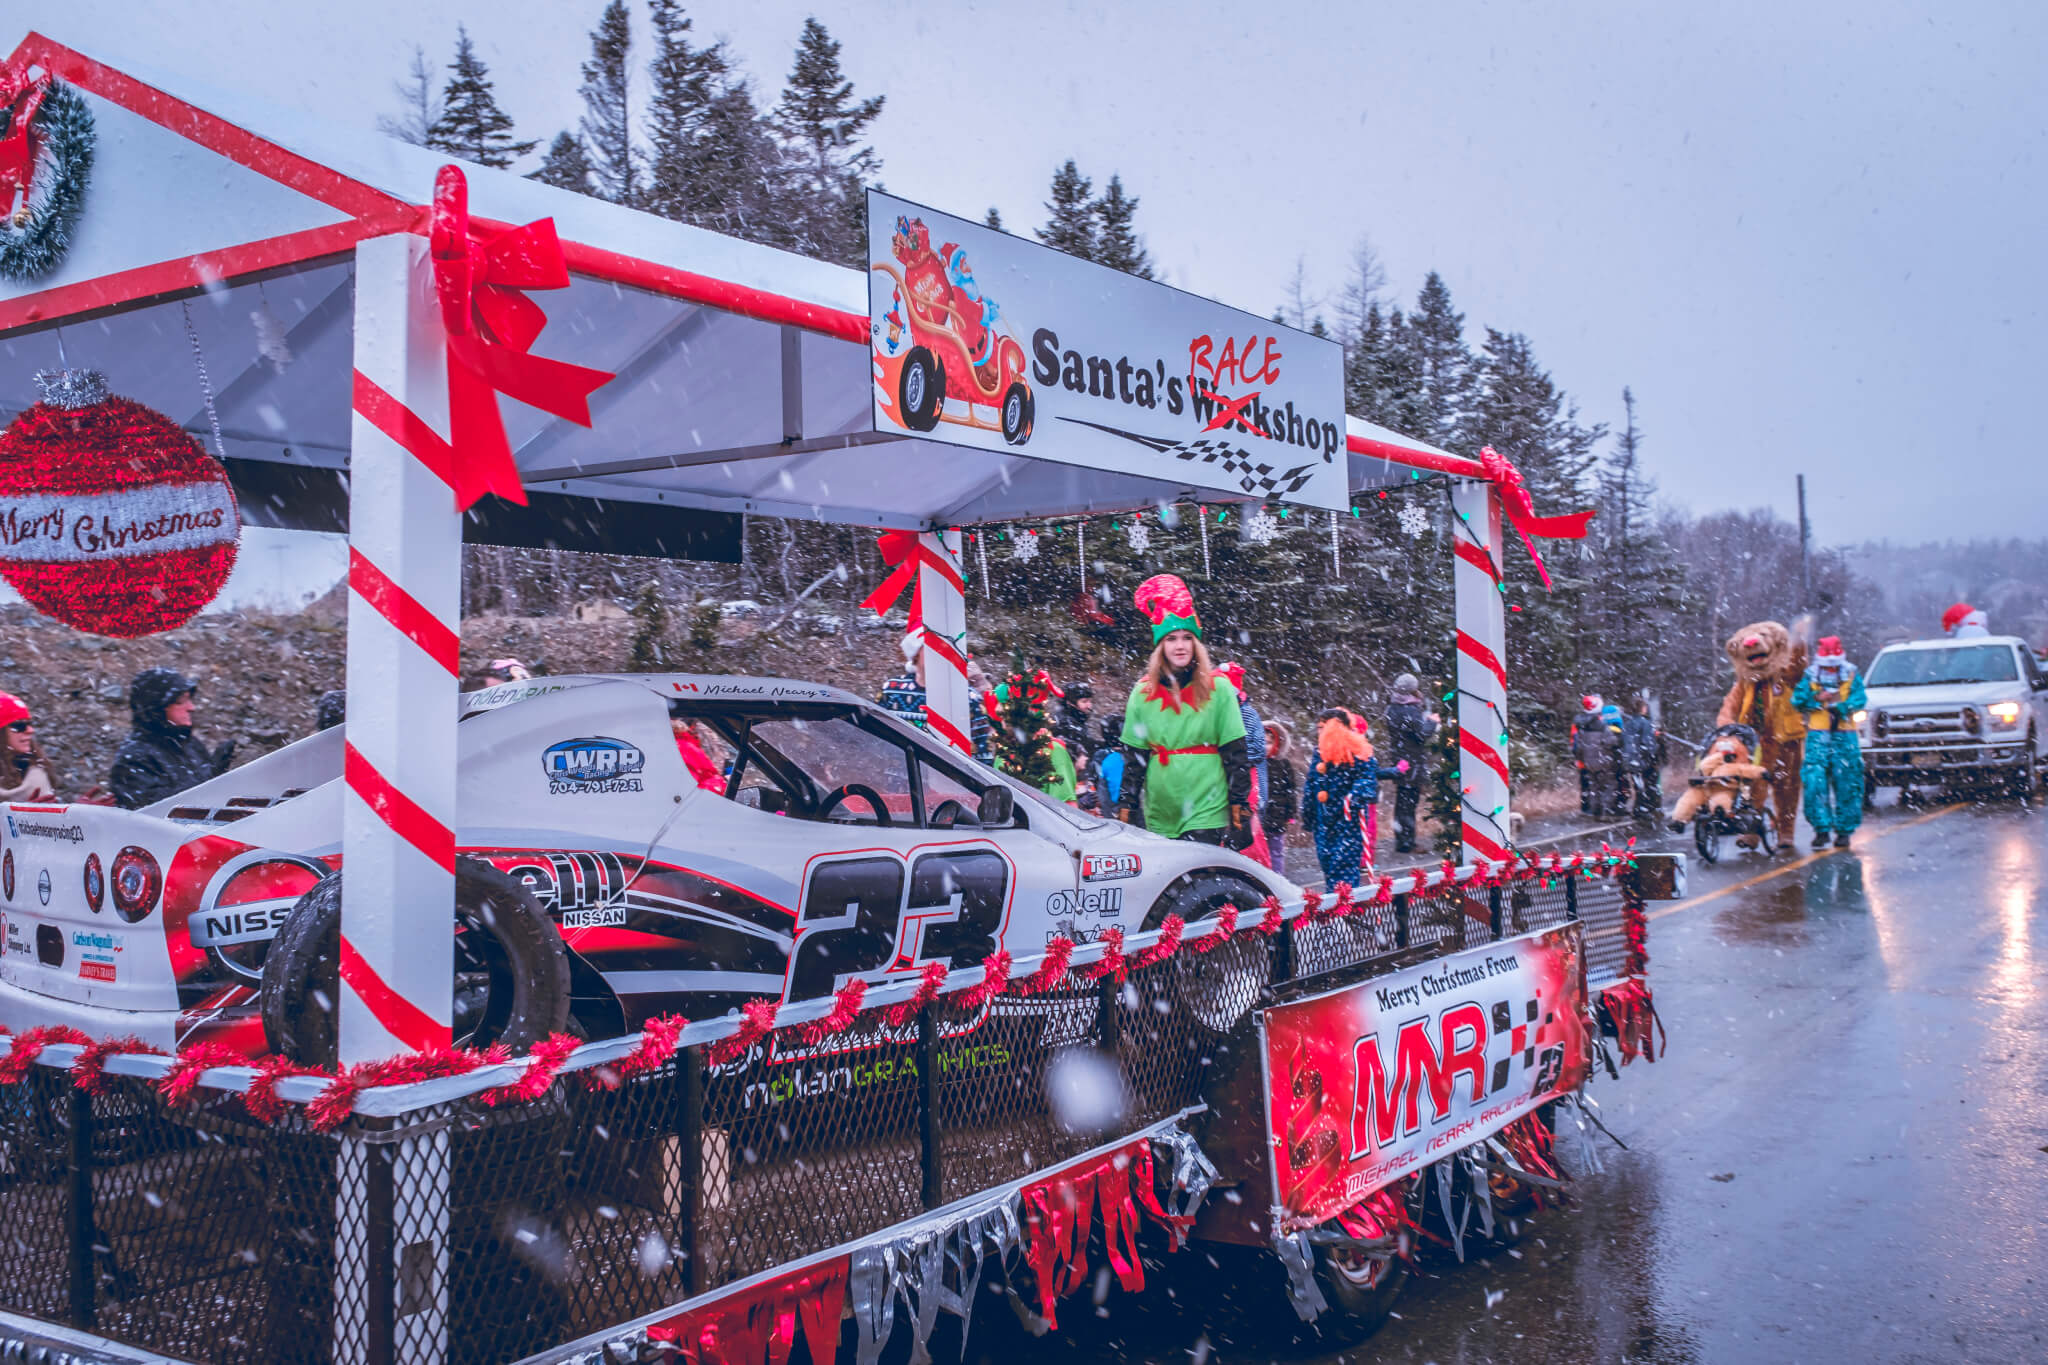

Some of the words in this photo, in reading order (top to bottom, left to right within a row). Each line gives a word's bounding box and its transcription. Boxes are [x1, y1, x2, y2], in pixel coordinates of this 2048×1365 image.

[1033, 328, 1183, 415] Santa's
[1190, 335, 1282, 386] RACE
[74, 508, 224, 552] Christmas
[704, 684, 764, 695] Michael
[771, 687, 816, 698] Neary
[206, 907, 292, 938] NISS
[564, 909, 625, 927] NISSAN
[781, 838, 1016, 1008] 23
[1376, 984, 1420, 1012] Merry
[1421, 962, 1486, 997] Christmas
[1486, 954, 1519, 977] From
